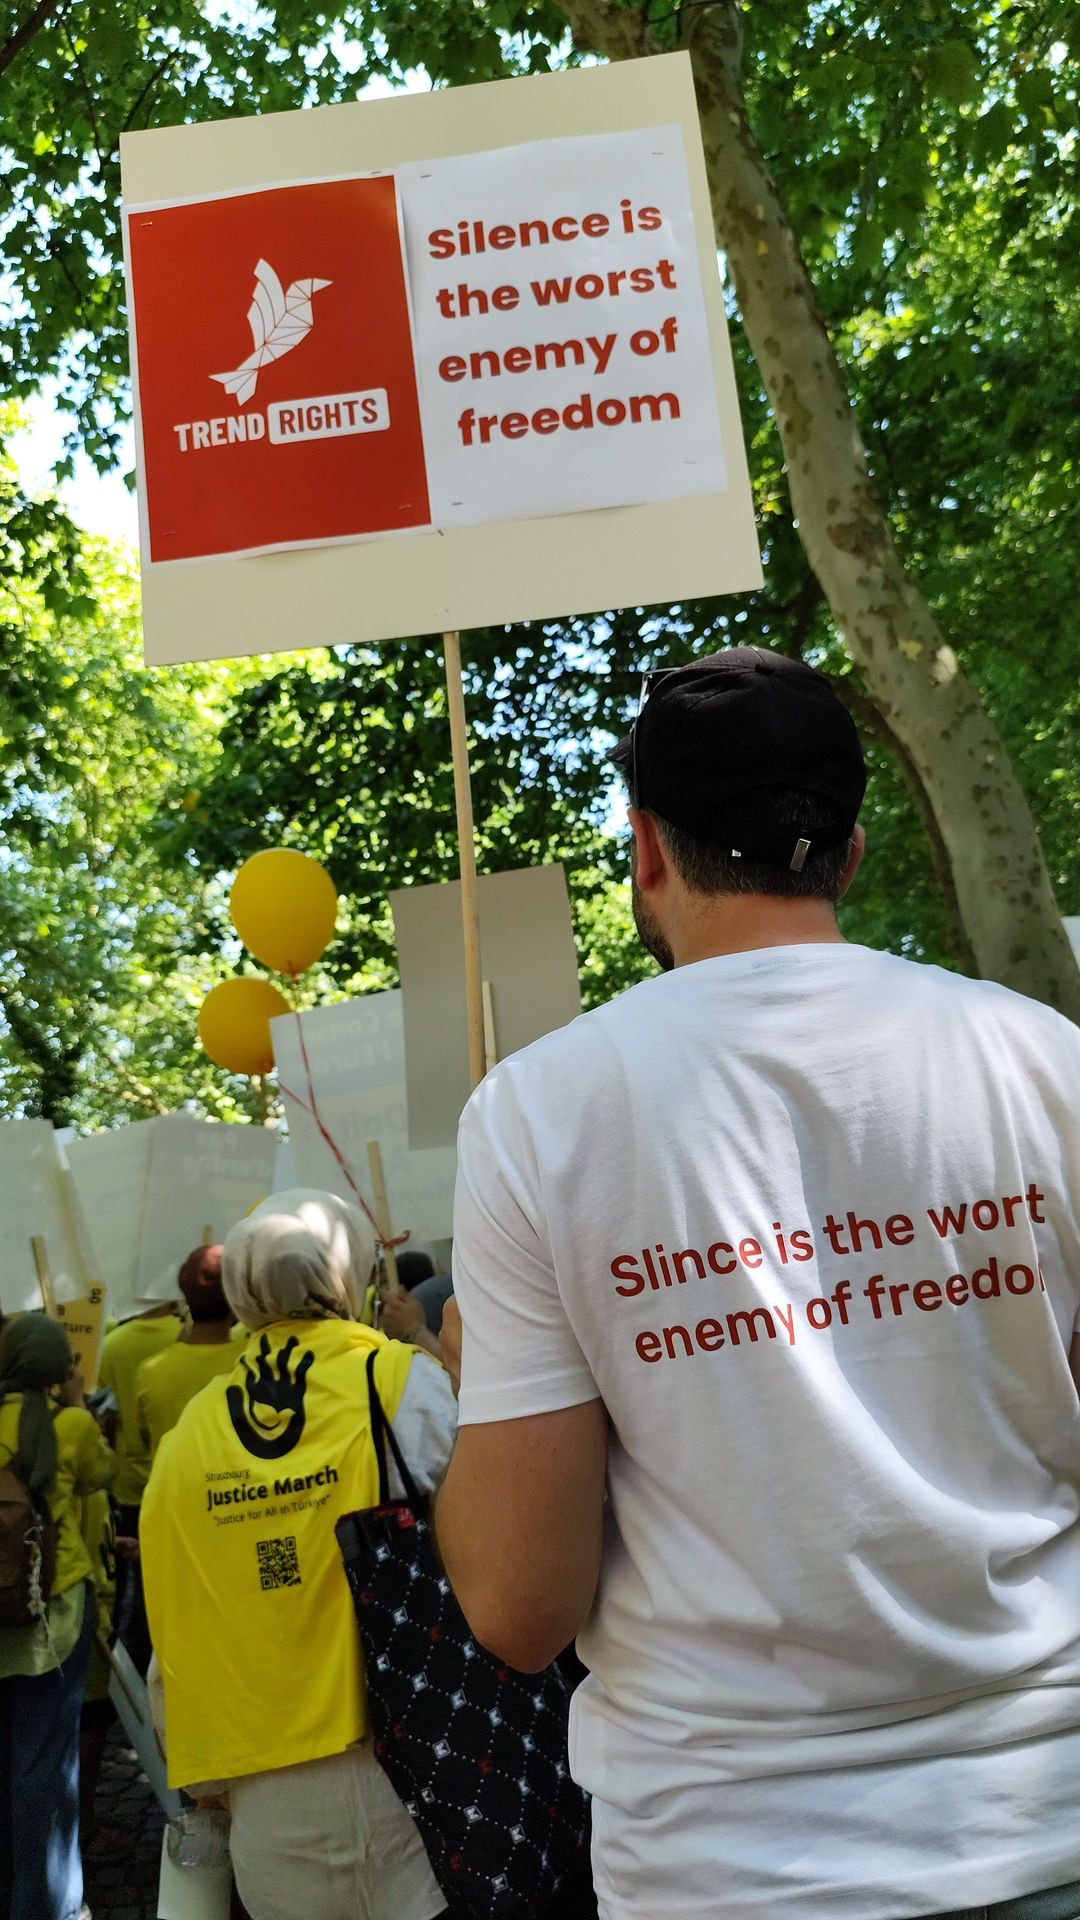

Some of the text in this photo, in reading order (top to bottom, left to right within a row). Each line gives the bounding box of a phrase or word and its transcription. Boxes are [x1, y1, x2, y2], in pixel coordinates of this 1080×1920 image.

[428, 199, 662, 260] Silence is
[435, 259, 678, 320] the worst
[437, 316, 679, 382] enemy of
[173, 397, 379, 452] TREND RIGHTS
[457, 391, 682, 447] freedom
[609, 1237, 765, 1298] Slince
[770, 1220, 816, 1265] is
[823, 1211, 914, 1255] the
[635, 1257, 1045, 1364] enemy of freedo
[206, 1465, 339, 1511] Justice March
[248, 1510, 262, 1520] for
[265, 1506, 278, 1517] All
[280, 1505, 290, 1515] in
